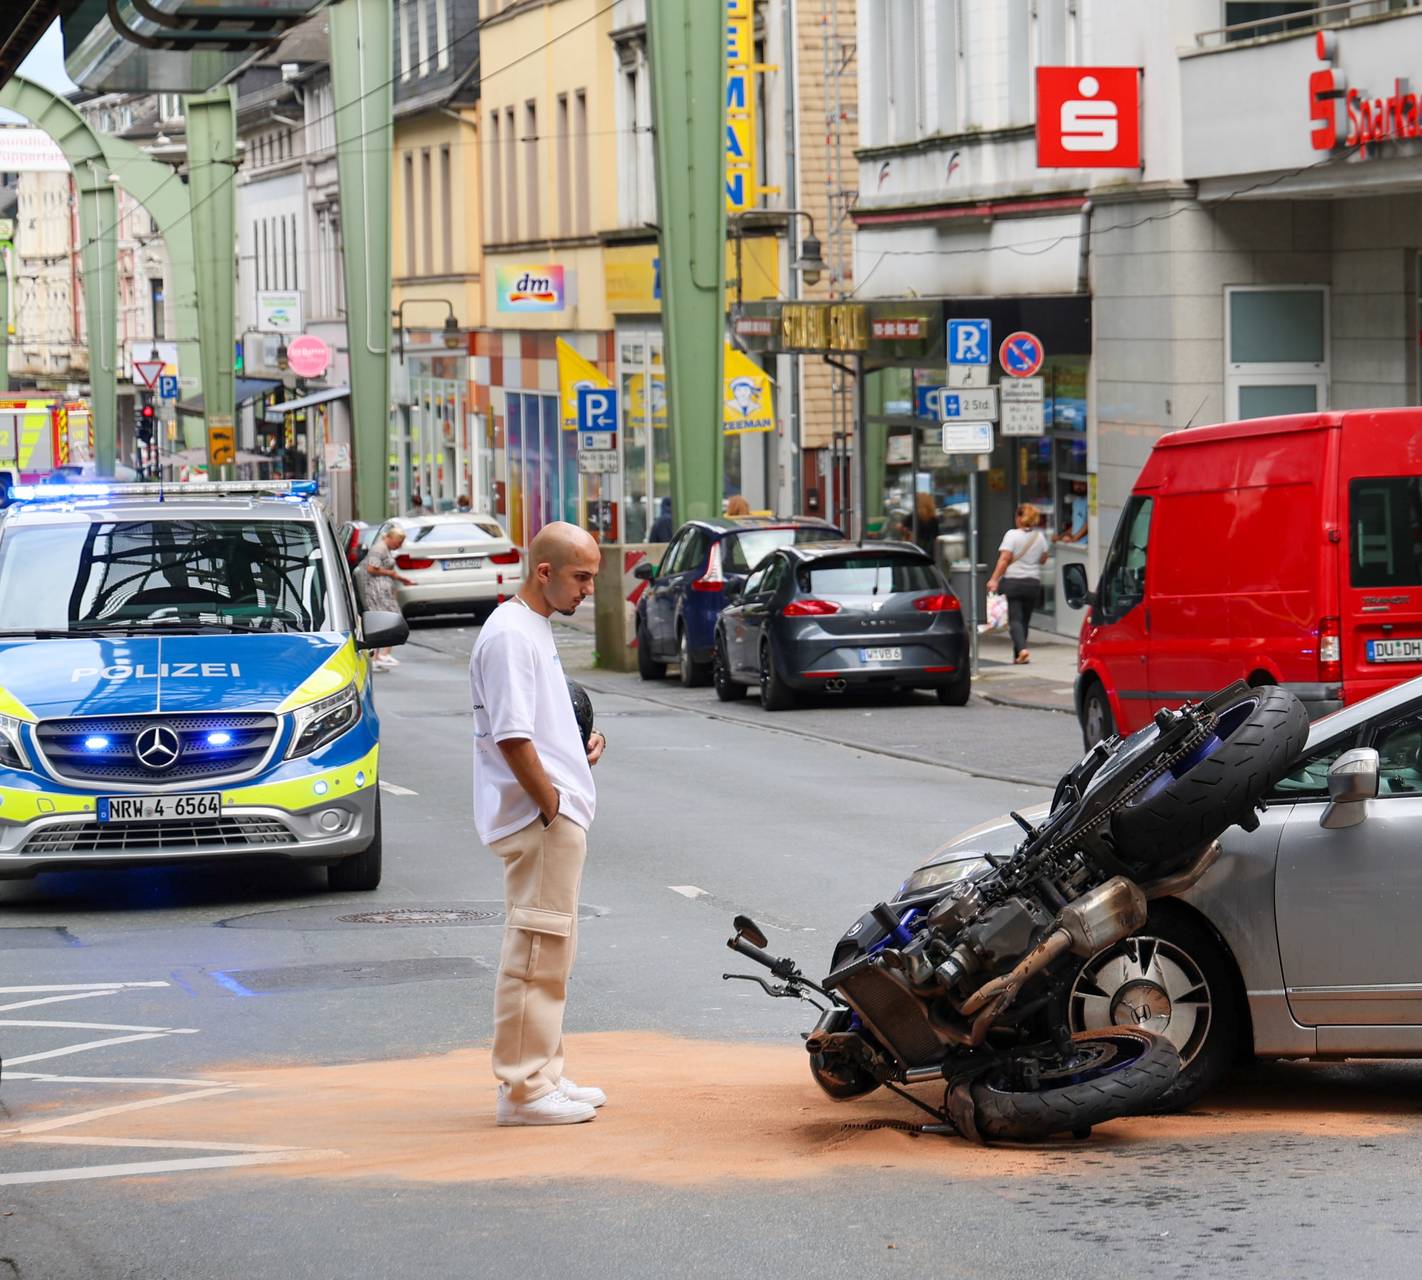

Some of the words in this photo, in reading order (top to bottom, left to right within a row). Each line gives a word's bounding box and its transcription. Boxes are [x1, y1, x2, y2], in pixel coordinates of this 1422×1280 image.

[516, 273, 549, 291] dm
[585, 393, 608, 427] P
[962, 400, 969, 410] 2
[723, 419, 771, 430] ZEEMAN
[1375, 643, 1394, 656] DU
[1403, 642, 1421, 656] DH
[71, 662, 241, 683] POLIZEI
[109, 799, 143, 819] NRW
